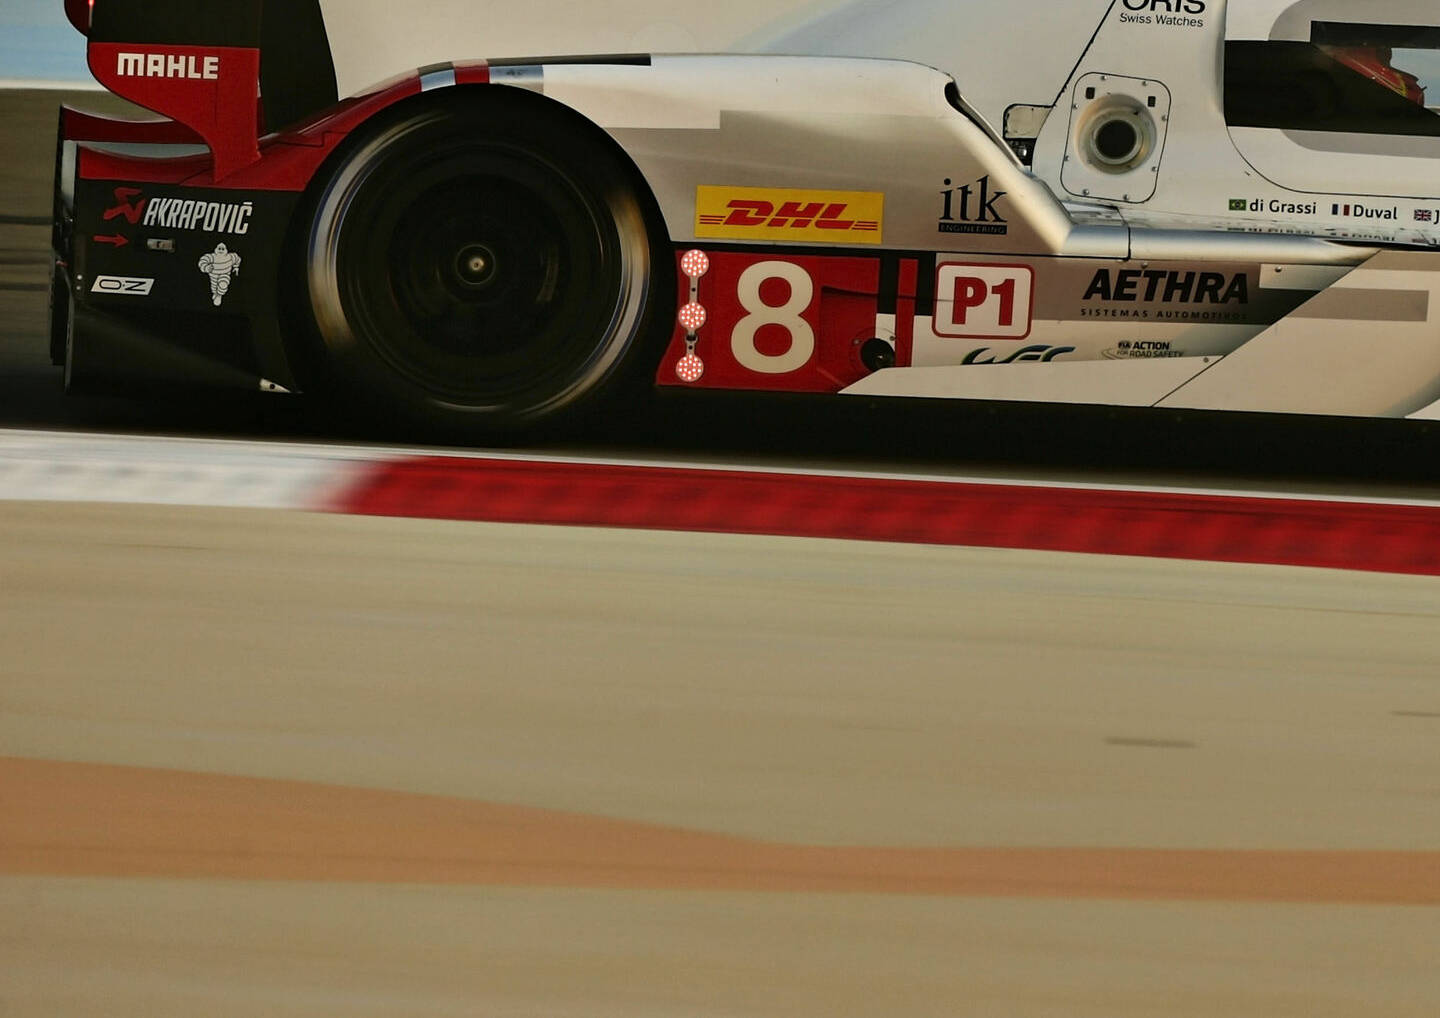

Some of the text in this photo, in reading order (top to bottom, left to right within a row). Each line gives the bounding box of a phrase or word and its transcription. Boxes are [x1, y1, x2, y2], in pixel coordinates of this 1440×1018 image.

[1119, 13, 1204, 28] Swiss Watches
[117, 53, 219, 80] MAHLE
[939, 174, 1008, 223] itk
[1249, 198, 1317, 215] di Grassi
[723, 199, 856, 230] DHL
[1353, 204, 1398, 221] Duval
[940, 223, 1006, 234] ENGINEERING
[1082, 268, 1249, 305] AETHRA
[951, 276, 1016, 327] P1
[730, 260, 816, 374] 8
[1080, 308, 1149, 318] SISTEMAS
[1129, 350, 1152, 358] ROAD
[1153, 350, 1184, 358] SAFETY
[1132, 341, 1170, 351] ACTION
